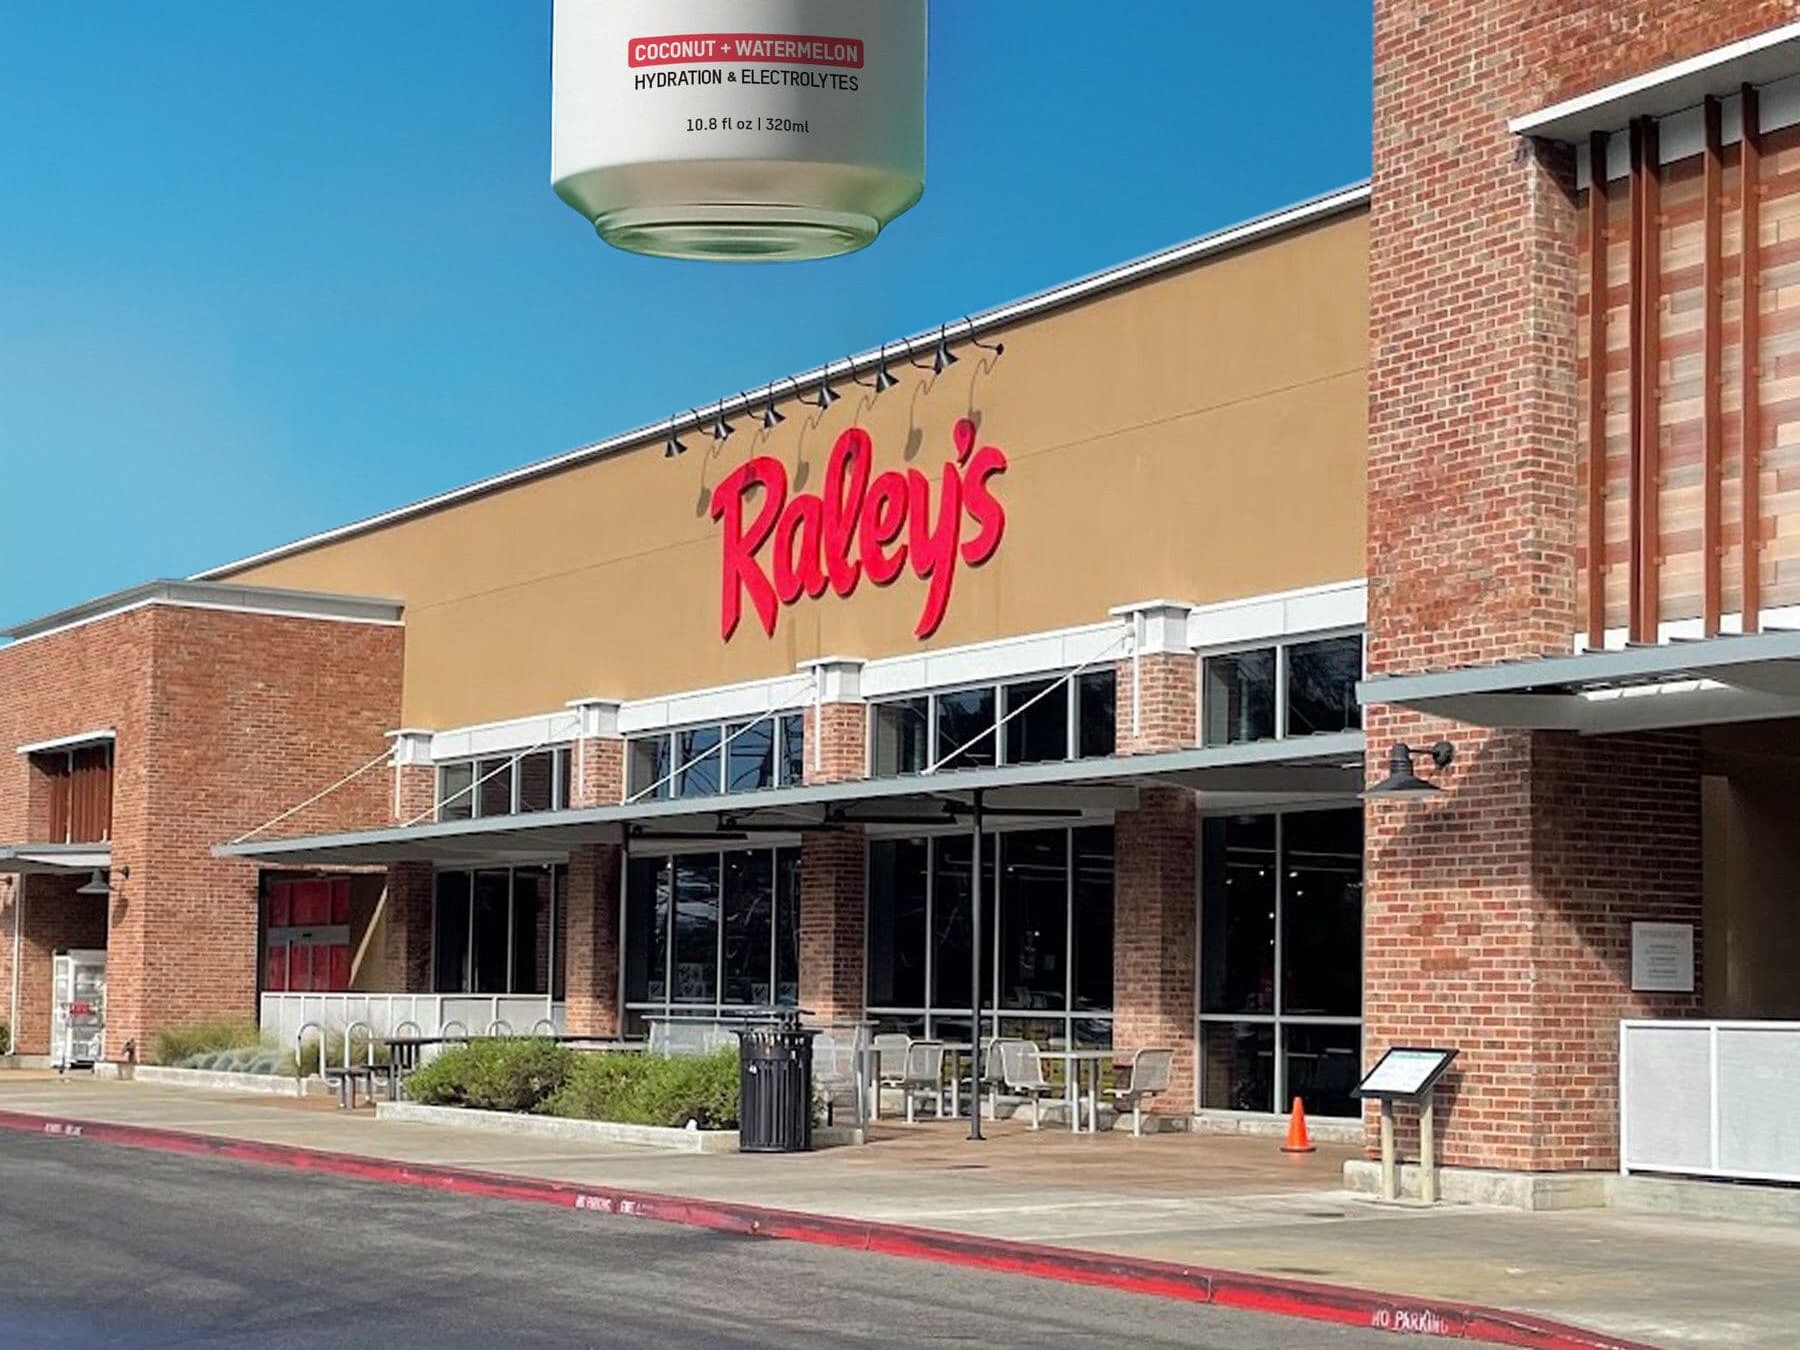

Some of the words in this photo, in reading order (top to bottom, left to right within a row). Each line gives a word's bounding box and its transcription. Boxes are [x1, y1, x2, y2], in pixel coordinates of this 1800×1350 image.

[634, 39, 716, 62] COCONUT
[720, 43, 731, 54] +
[734, 39, 859, 63] WATERMELON
[634, 68, 722, 91] HYDRATION
[727, 71, 737, 83] &
[741, 68, 859, 92] ELECTROLYTES
[686, 117, 717, 132] 10.8
[721, 117, 732, 130] fl
[736, 120, 753, 131] oz
[765, 117, 809, 134] 320ml
[709, 417, 1008, 645] Raley's
[1371, 1309, 1390, 1327] NO
[1391, 1309, 1449, 1334] PARKING
